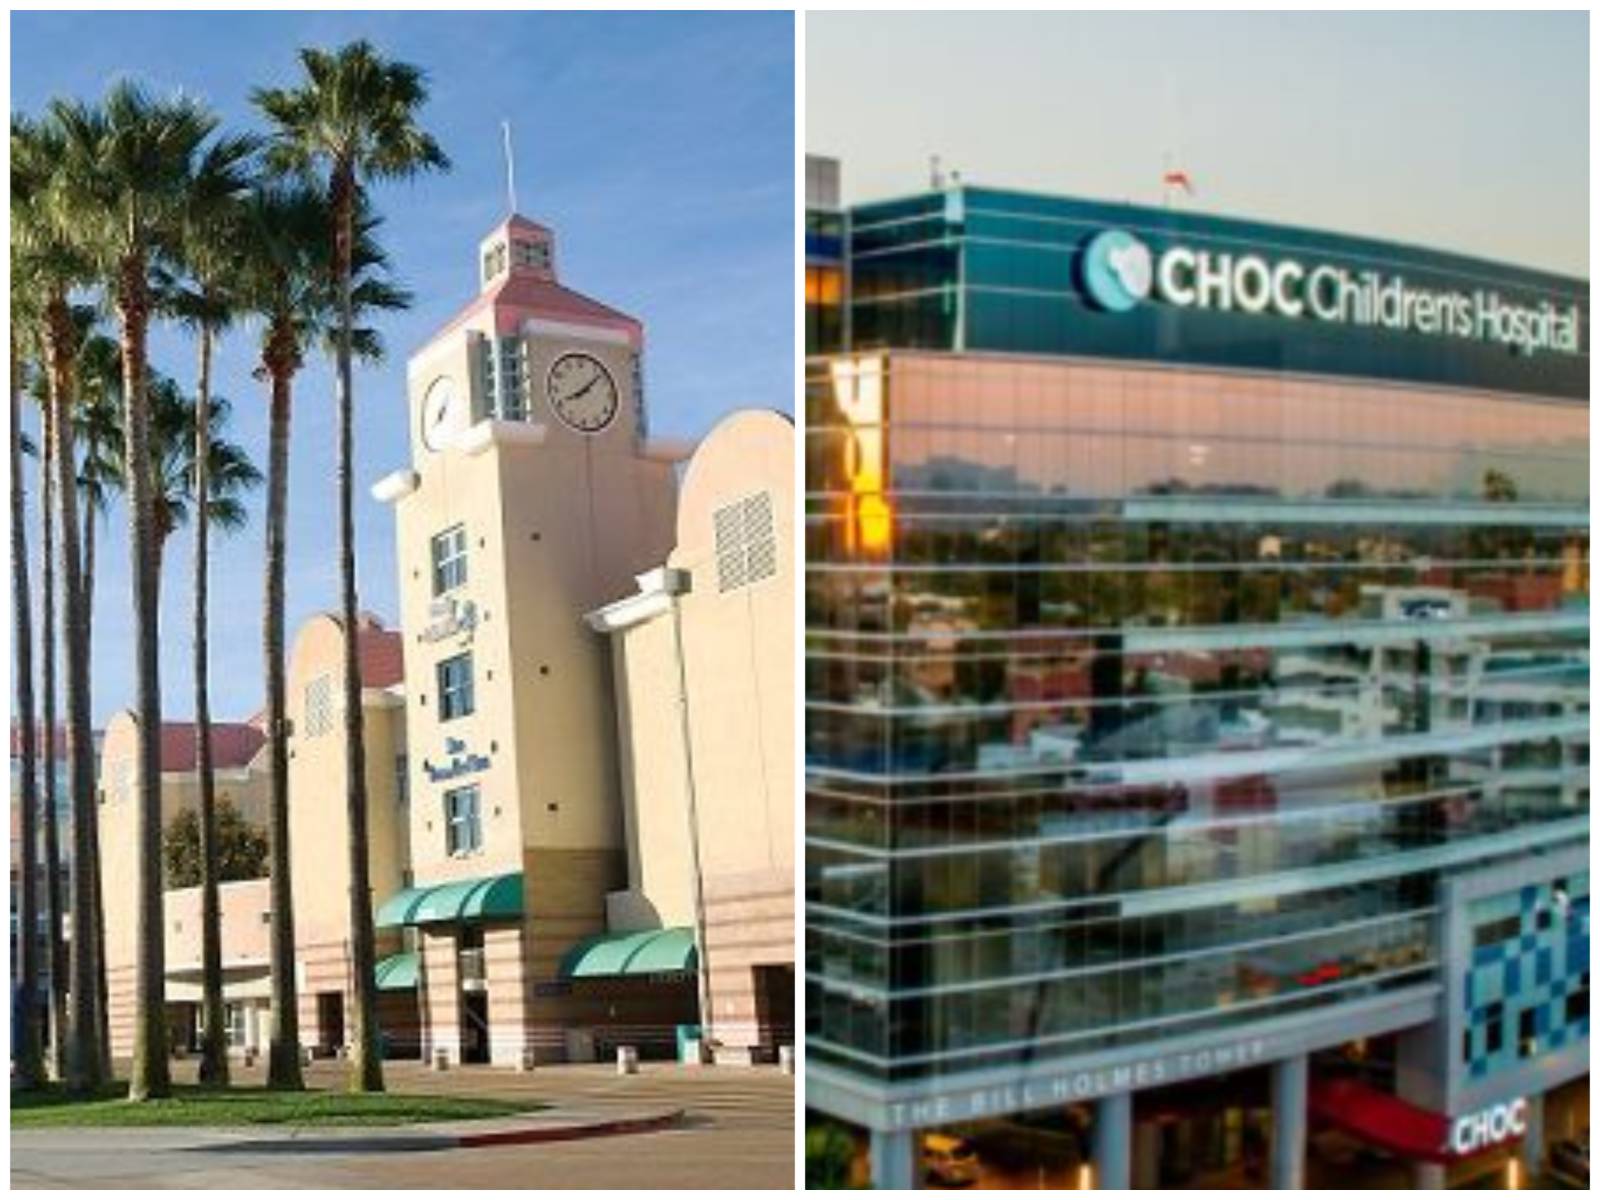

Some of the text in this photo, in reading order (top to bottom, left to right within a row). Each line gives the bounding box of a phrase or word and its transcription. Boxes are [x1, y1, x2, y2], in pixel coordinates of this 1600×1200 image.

[1159, 247, 1304, 317] CHOC
[1474, 289, 1578, 357] Hospital
[891, 1095, 950, 1127] THE
[970, 1081, 1033, 1118] BILL
[1053, 1062, 1166, 1098] HOLMES
[1454, 1097, 1528, 1154] CHOC
